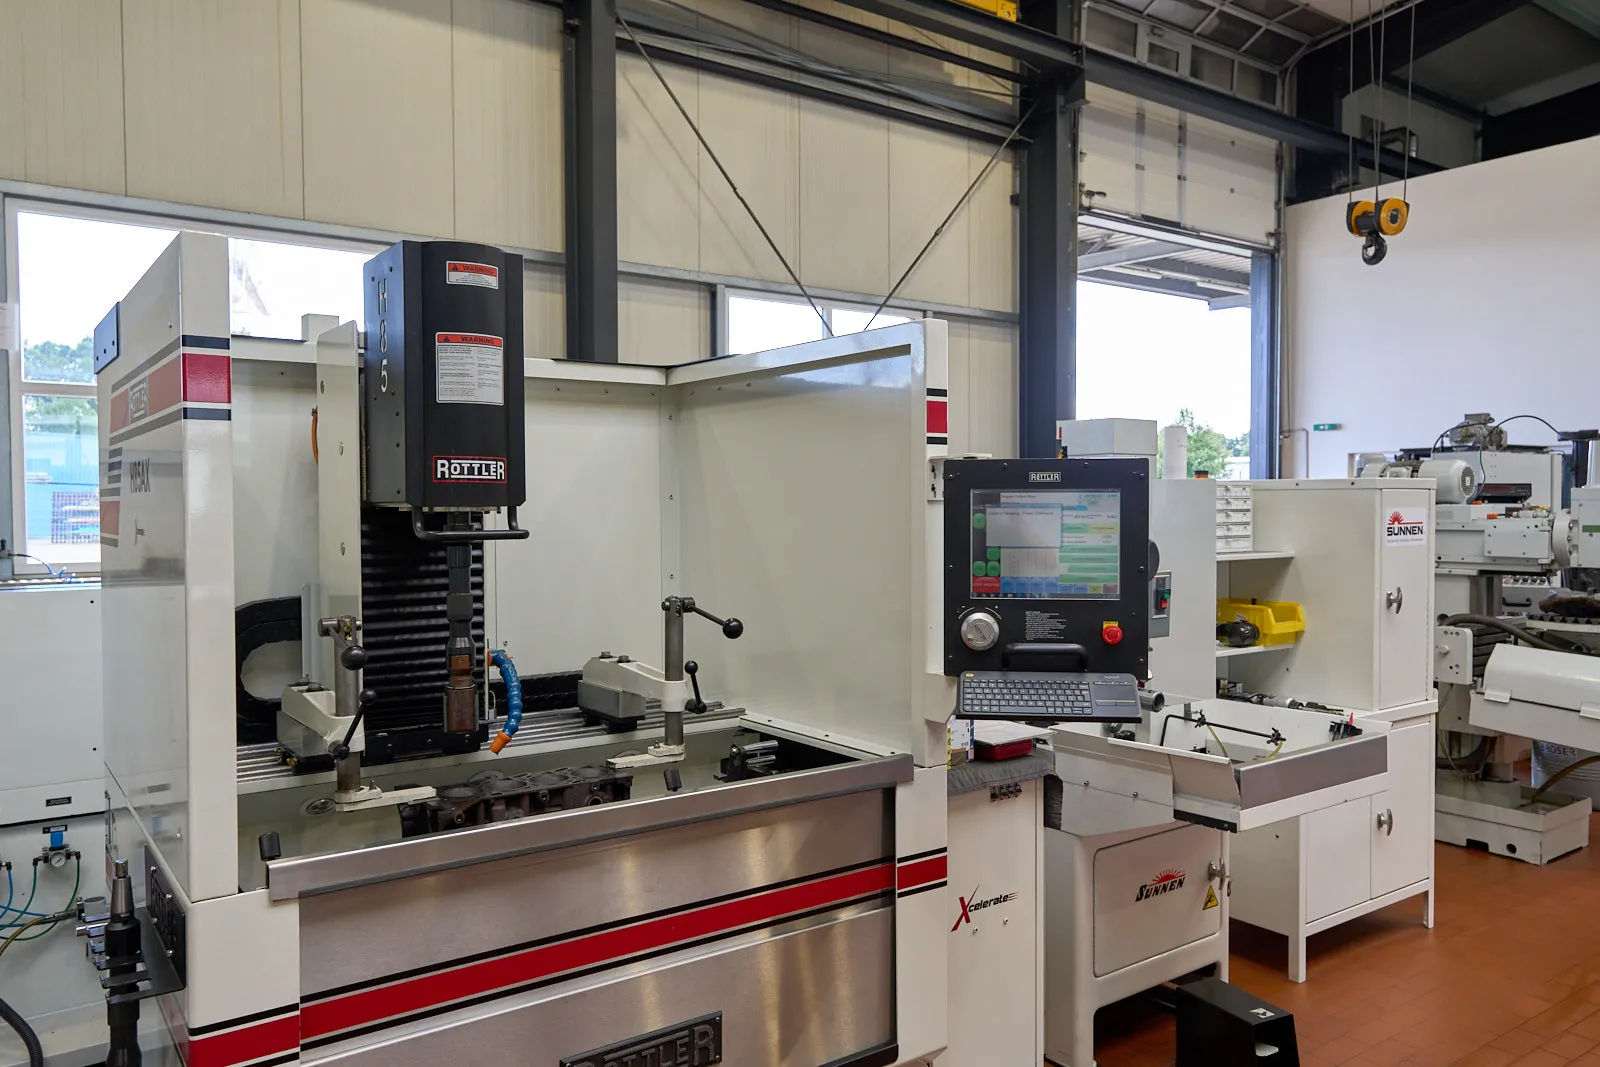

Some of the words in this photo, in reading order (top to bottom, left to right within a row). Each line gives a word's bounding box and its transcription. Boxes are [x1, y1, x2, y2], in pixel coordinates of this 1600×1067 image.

[462, 265, 494, 276] WARNING
[461, 336, 495, 345] WARNING
[436, 459, 505, 480] ROTTLER
[1386, 525, 1424, 537] SUNNEN
[1135, 876, 1186, 902] SUNNEN
[951, 884, 1012, 932] Xcelerate
[573, 1024, 714, 1067] TTLER
